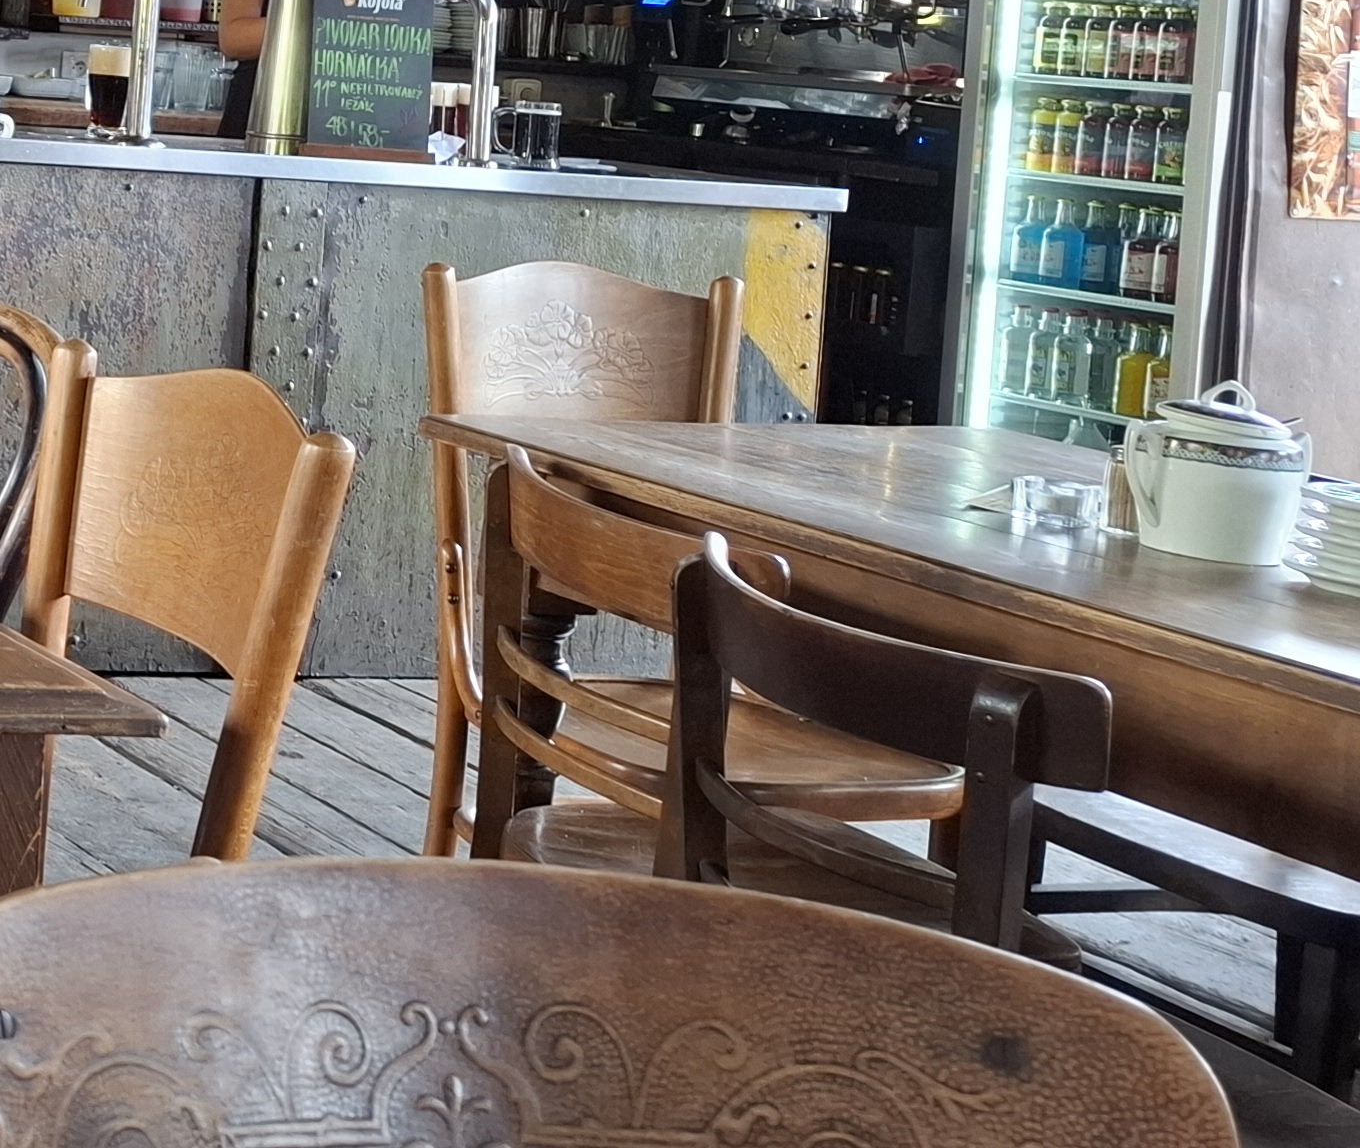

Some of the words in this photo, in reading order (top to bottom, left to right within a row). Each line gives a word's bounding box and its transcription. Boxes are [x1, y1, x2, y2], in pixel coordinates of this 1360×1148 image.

[314, 16, 381, 50] PIVOVAR
[383, 23, 432, 56] LOUKA
[340, 95, 375, 113] LEŽÁK
